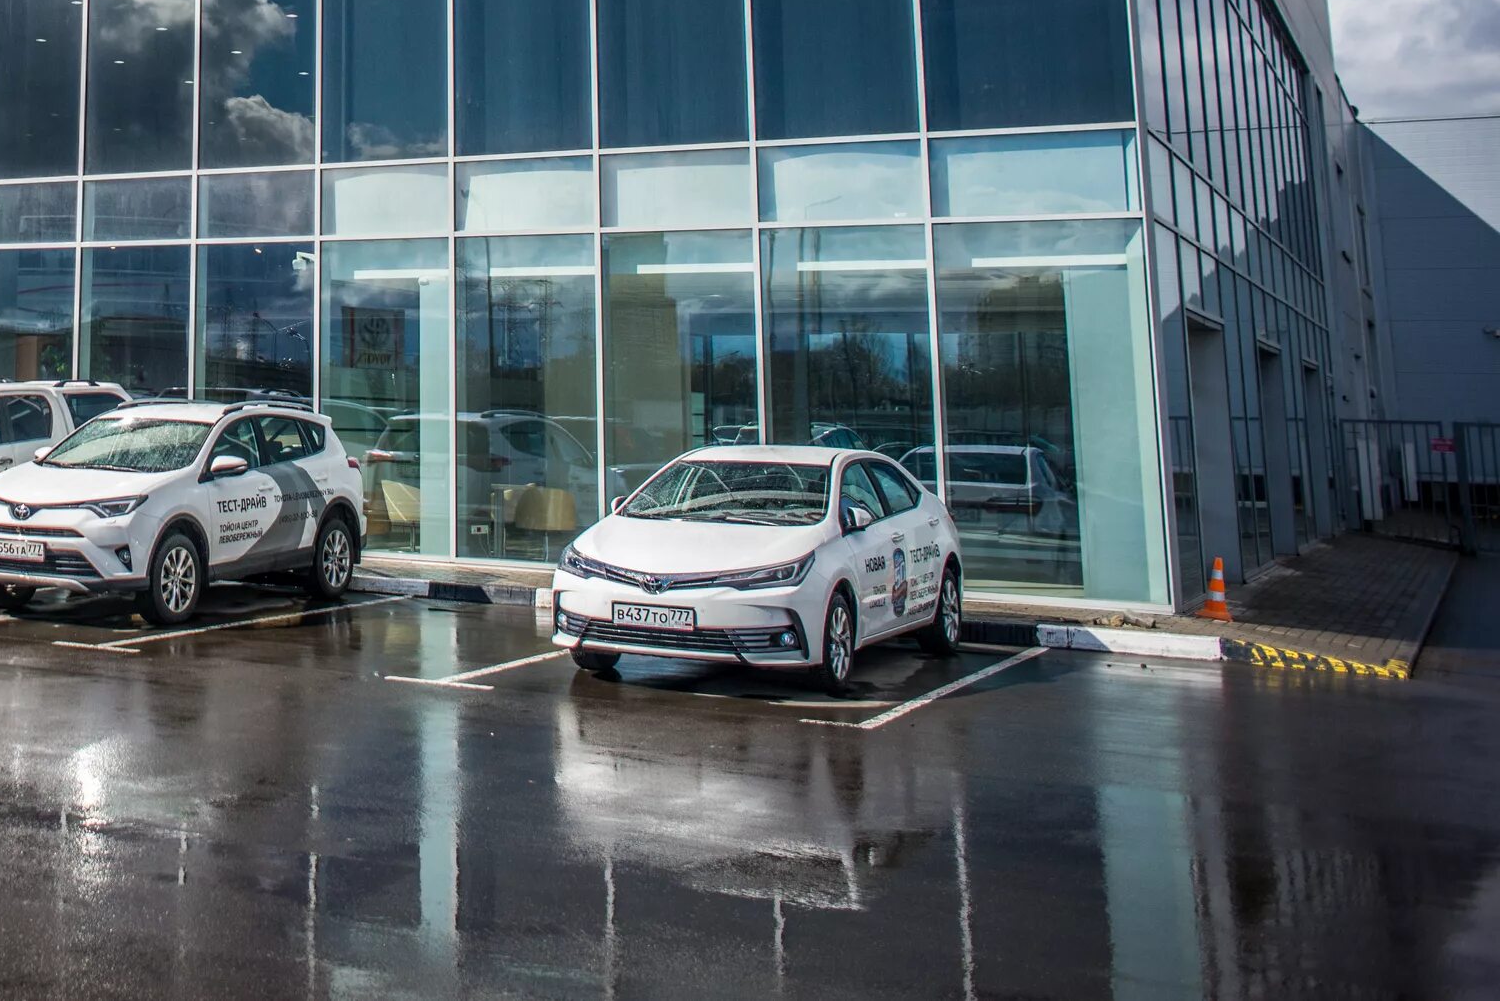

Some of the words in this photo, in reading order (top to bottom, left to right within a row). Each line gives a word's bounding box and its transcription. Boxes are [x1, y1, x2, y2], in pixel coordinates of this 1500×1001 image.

[217, 494, 267, 513] ТЕСТ-ДРАЙВ
[241, 519, 259, 529] ЦЕНТР
[865, 555, 886, 573] НОВАЯ
